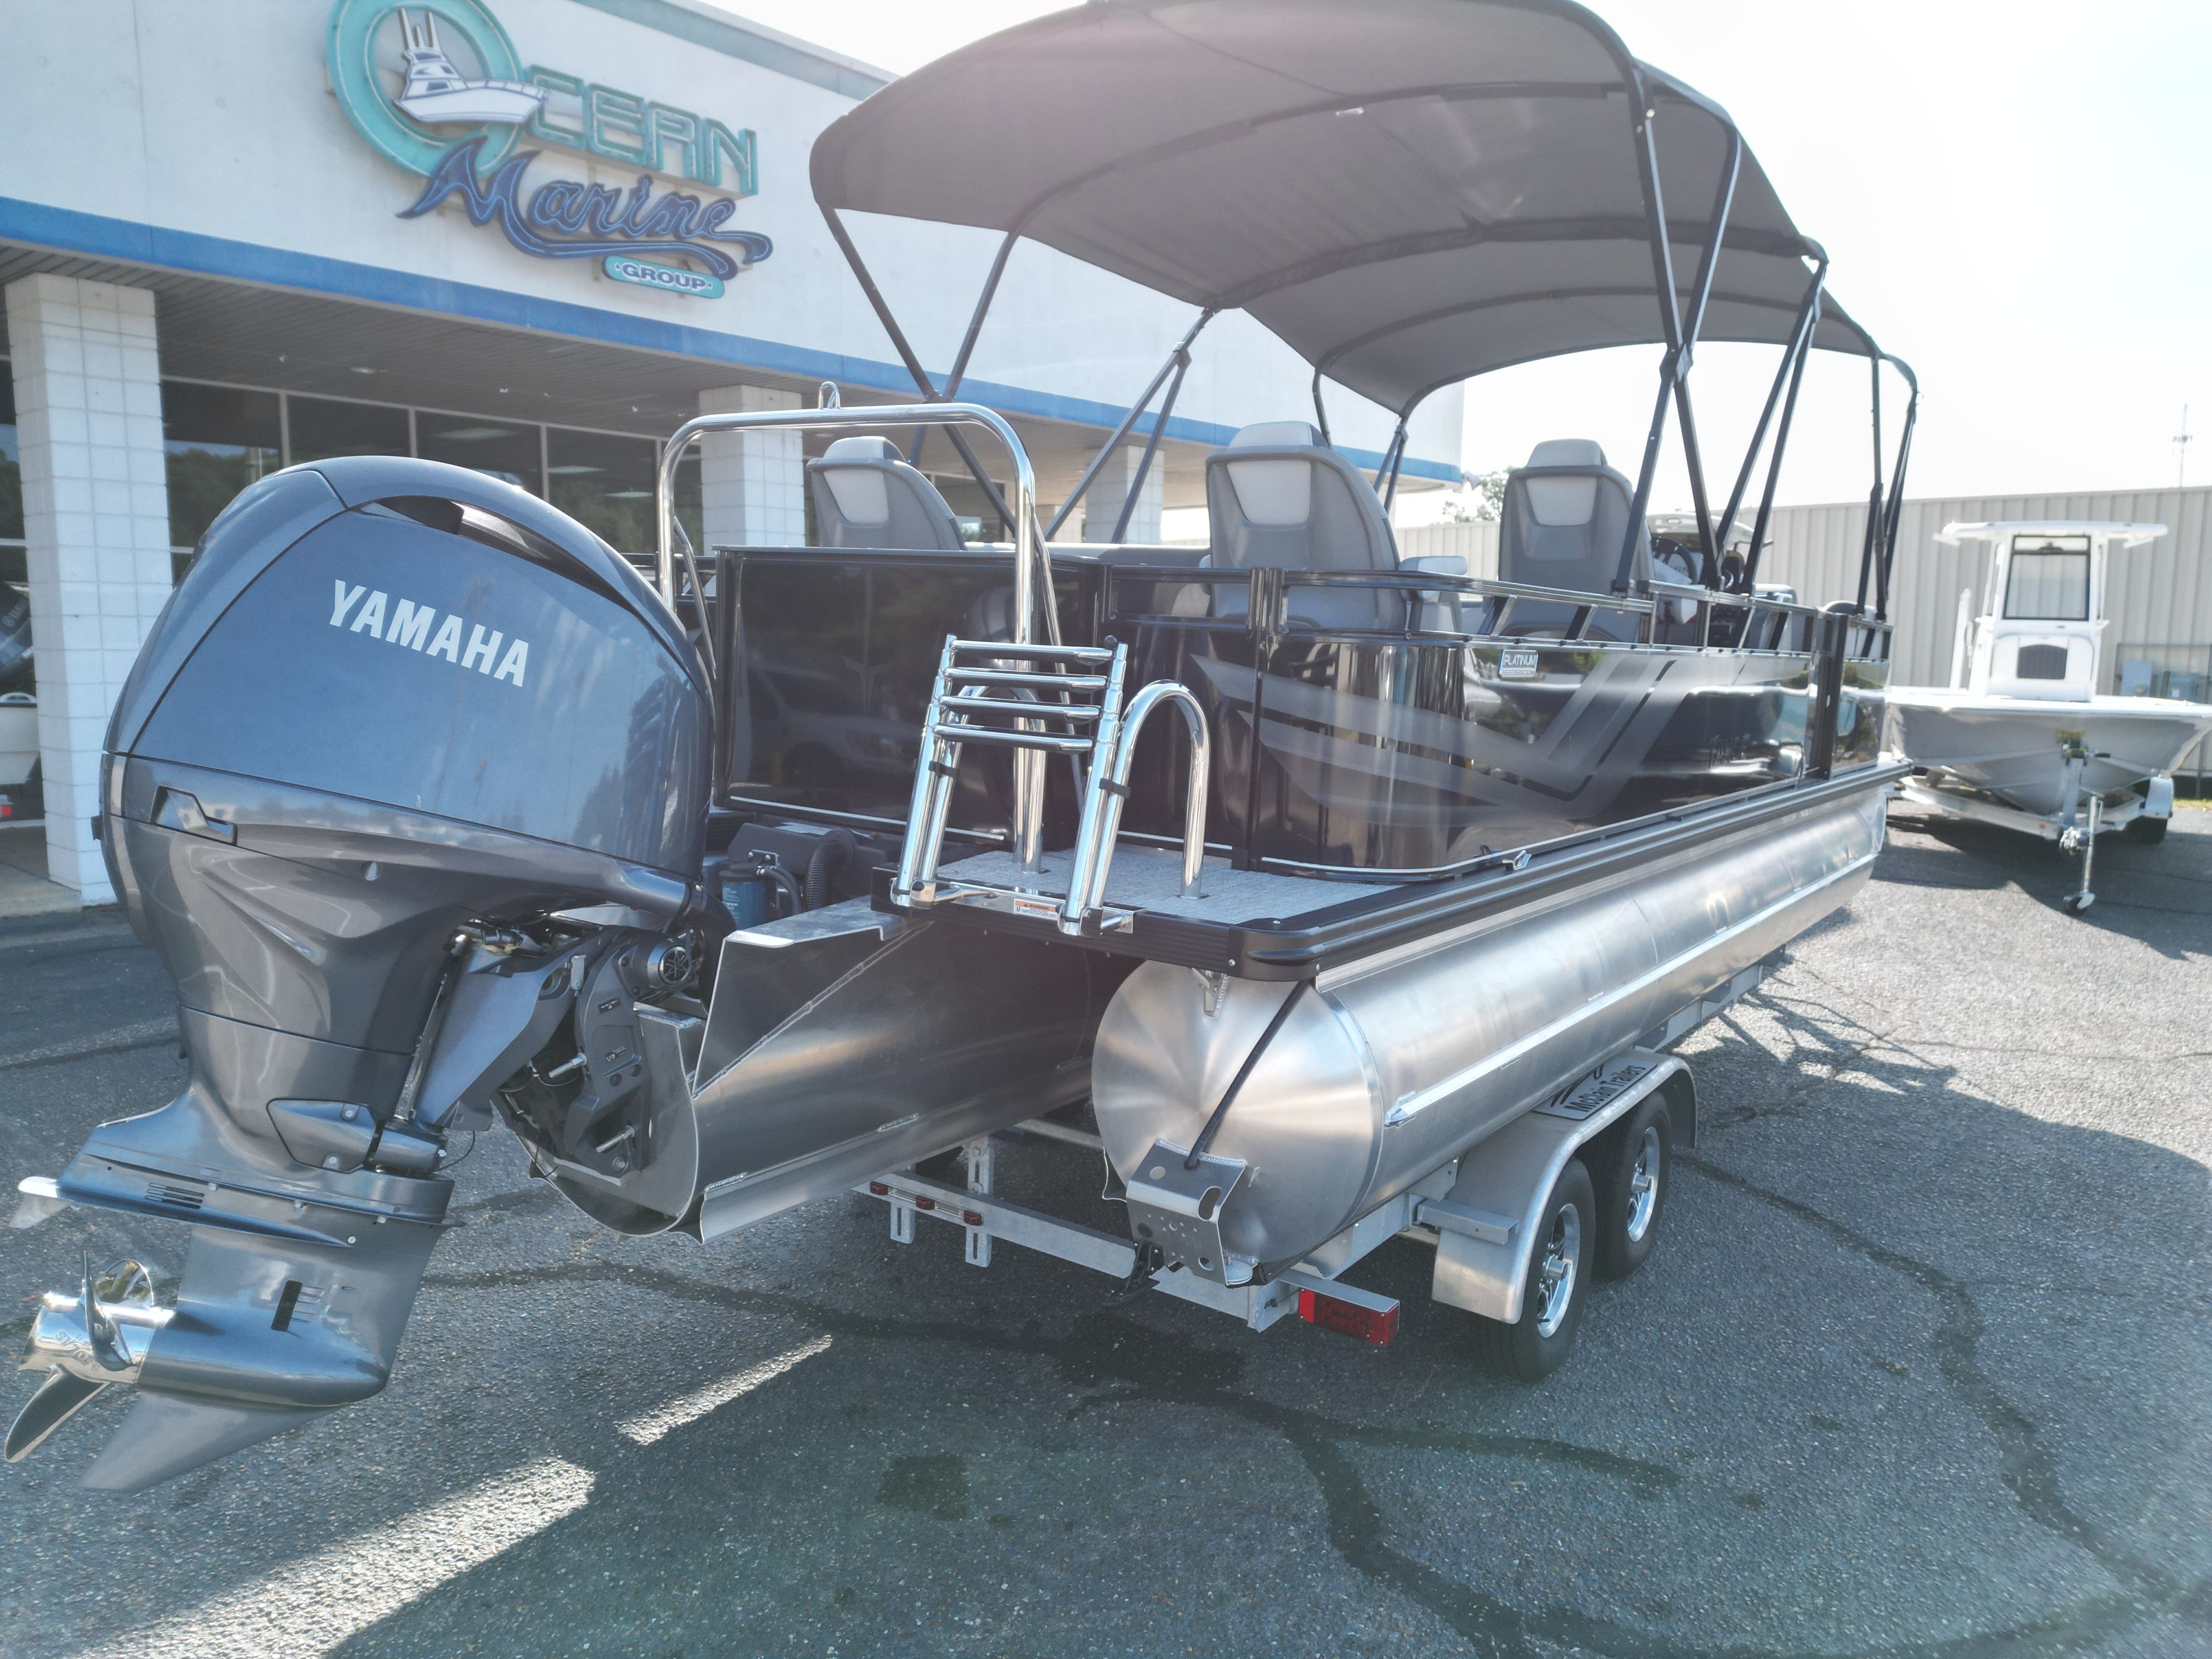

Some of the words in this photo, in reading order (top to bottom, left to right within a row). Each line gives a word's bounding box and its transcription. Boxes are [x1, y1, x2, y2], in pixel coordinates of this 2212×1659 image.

[326, 0, 759, 196] OCEAN
[395, 135, 774, 281] Marine
[622, 262, 708, 291] GROUP
[329, 579, 529, 687] YAMAHA
[1504, 654, 1537, 665] PLATINUM
[1564, 1086, 1618, 1112] McClain
[1599, 1065, 1646, 1089] Trailers
